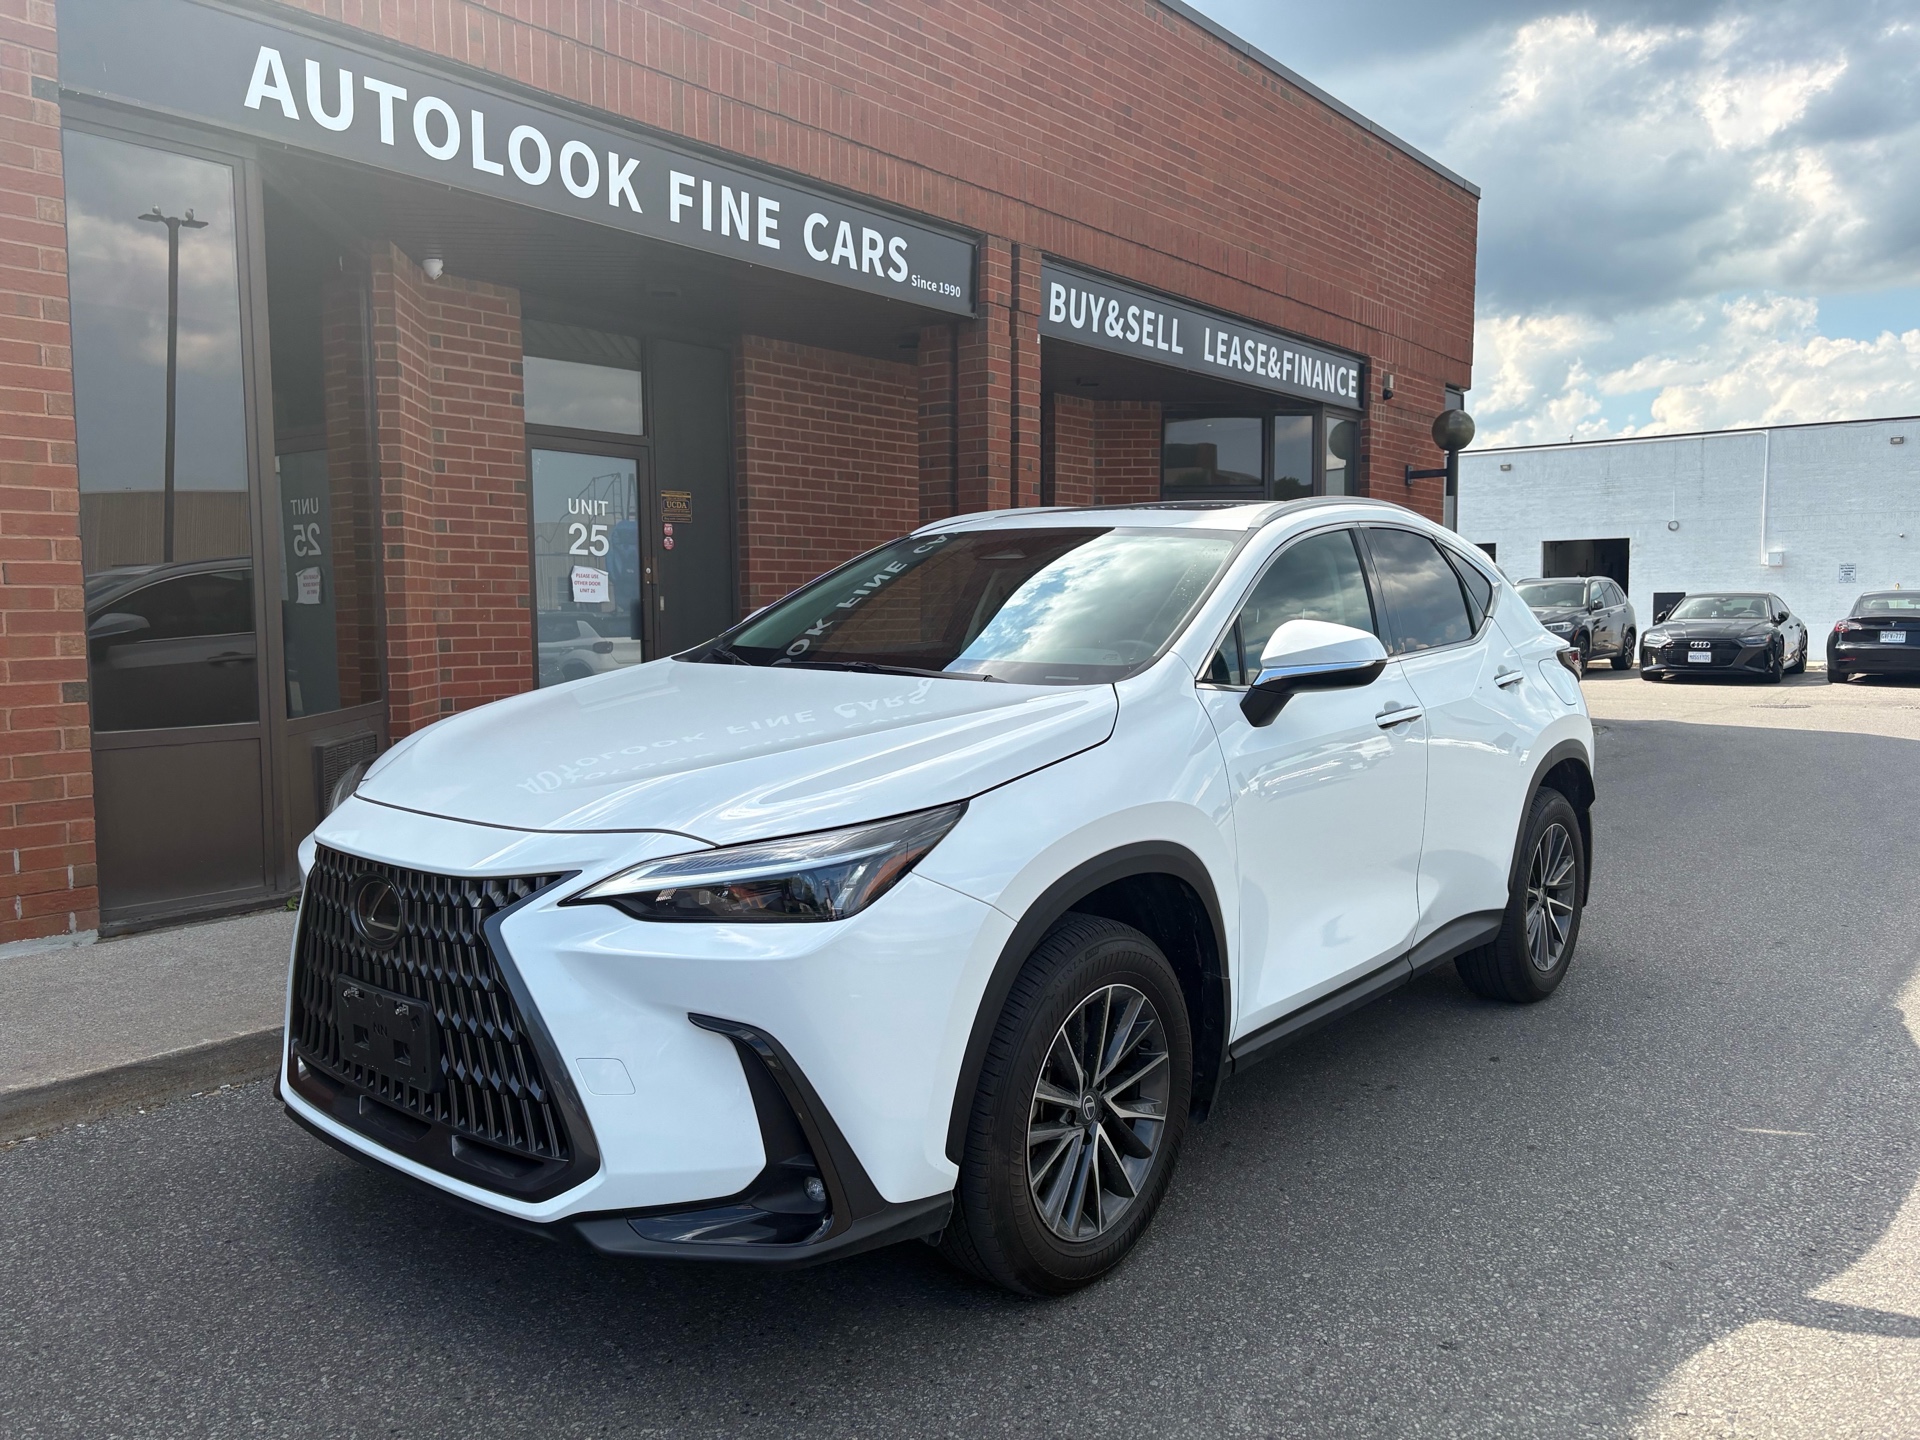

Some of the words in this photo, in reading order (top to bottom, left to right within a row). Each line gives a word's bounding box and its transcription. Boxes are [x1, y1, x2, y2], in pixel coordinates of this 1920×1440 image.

[244, 46, 643, 214] AUTOLOOK
[670, 170, 780, 250] FINE
[803, 213, 908, 283] CARS
[911, 275, 937, 292] Since
[938, 282, 961, 298] 1990
[1049, 282, 1184, 355] BUY&SELL
[1204, 327, 1357, 398] LEASE&FINANCE
[568, 498, 608, 516] UNIT
[666, 501, 687, 509] UCDA
[568, 523, 609, 556] 25
